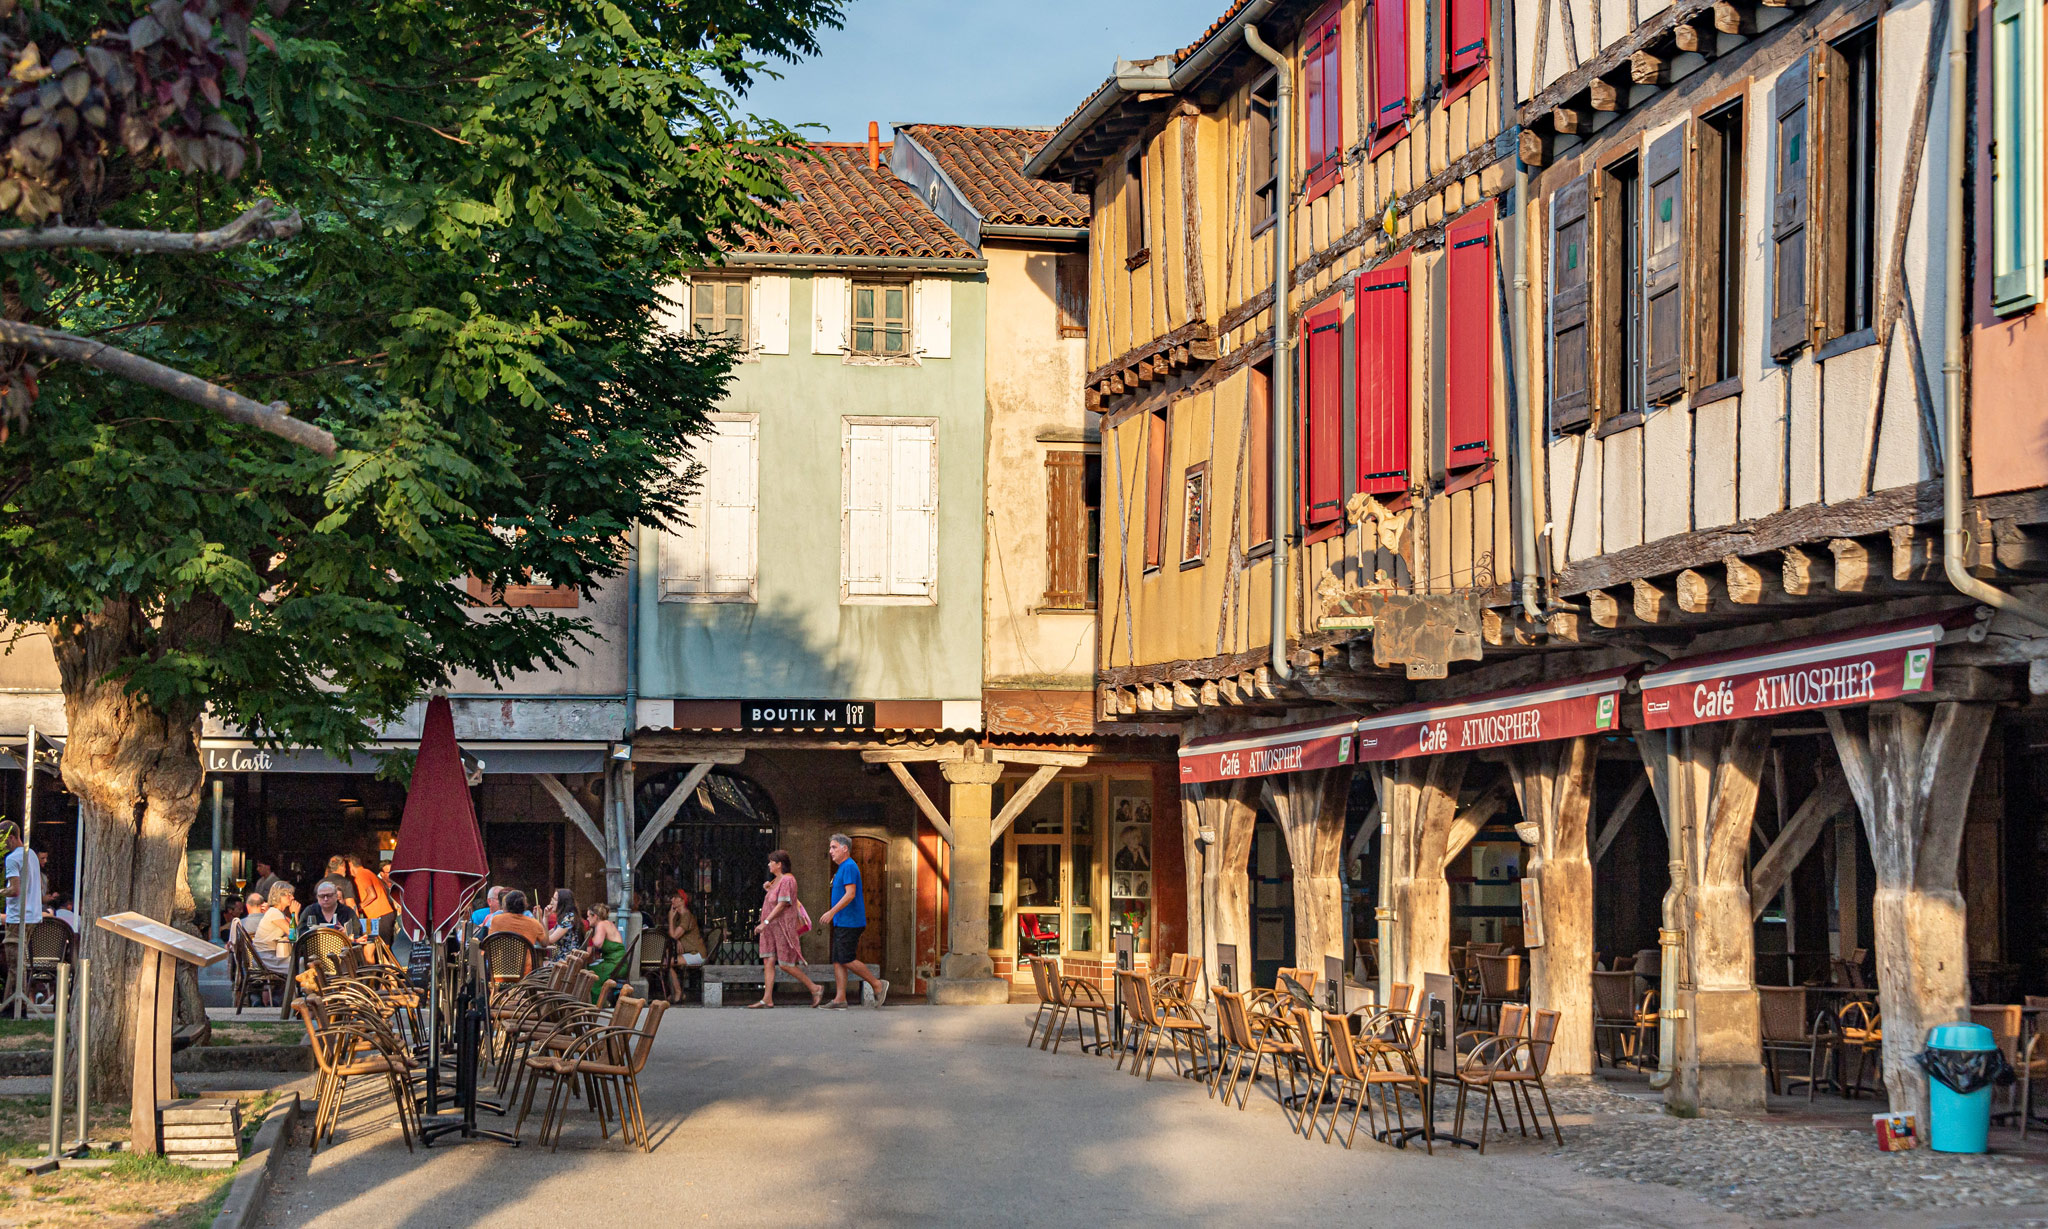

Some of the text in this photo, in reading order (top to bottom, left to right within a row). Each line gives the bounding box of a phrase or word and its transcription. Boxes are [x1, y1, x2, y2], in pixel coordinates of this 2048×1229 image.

[1693, 660, 1876, 718] Café ATMOSPHER
[752, 708, 836, 721] BOUTIK M
[1419, 708, 1541, 753] Café ATMOSPHER
[209, 749, 273, 771] Le Casti
[1219, 745, 1303, 776] Café ATMOSPHER
